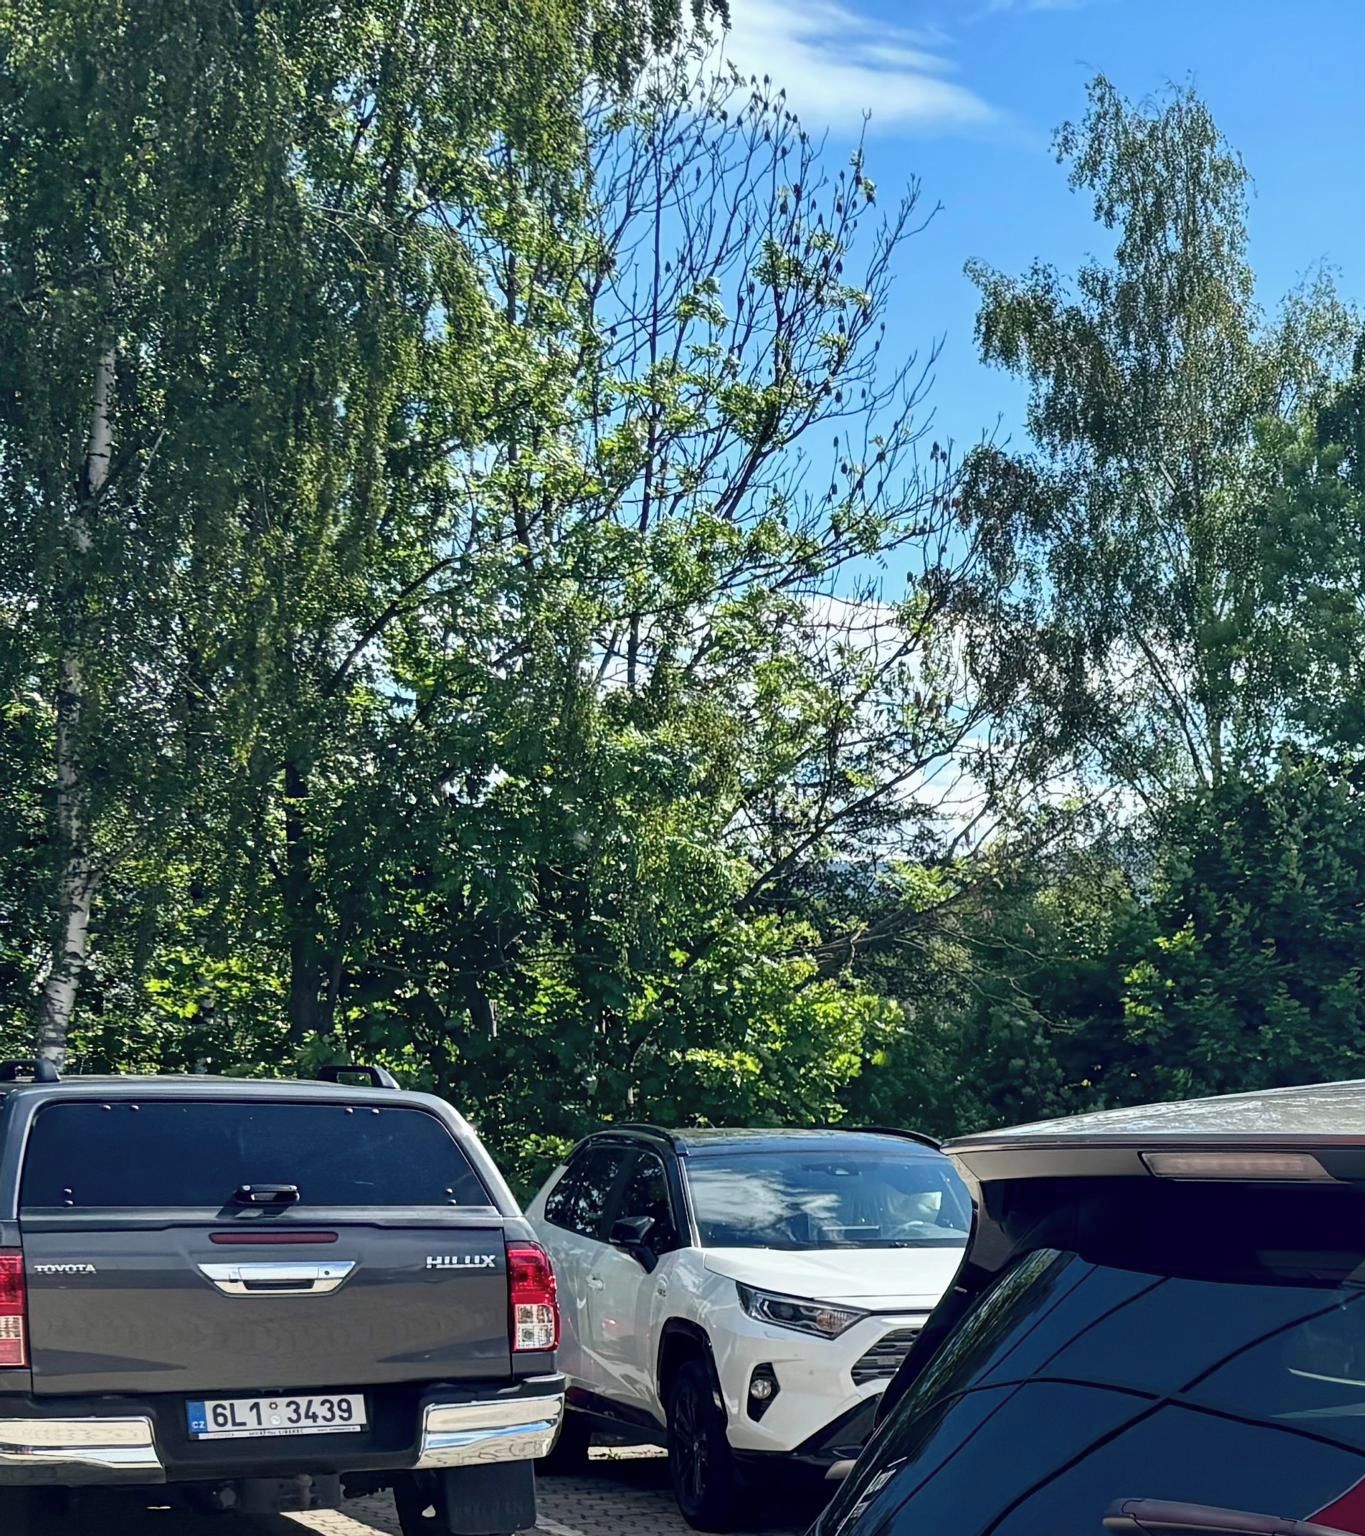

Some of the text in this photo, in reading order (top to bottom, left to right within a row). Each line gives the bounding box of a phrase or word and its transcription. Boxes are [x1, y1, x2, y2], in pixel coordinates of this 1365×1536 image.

[34, 1263, 97, 1274] TOYOTA
[426, 1254, 496, 1269] HILUX
[212, 1398, 353, 1428] 6L1 3439
